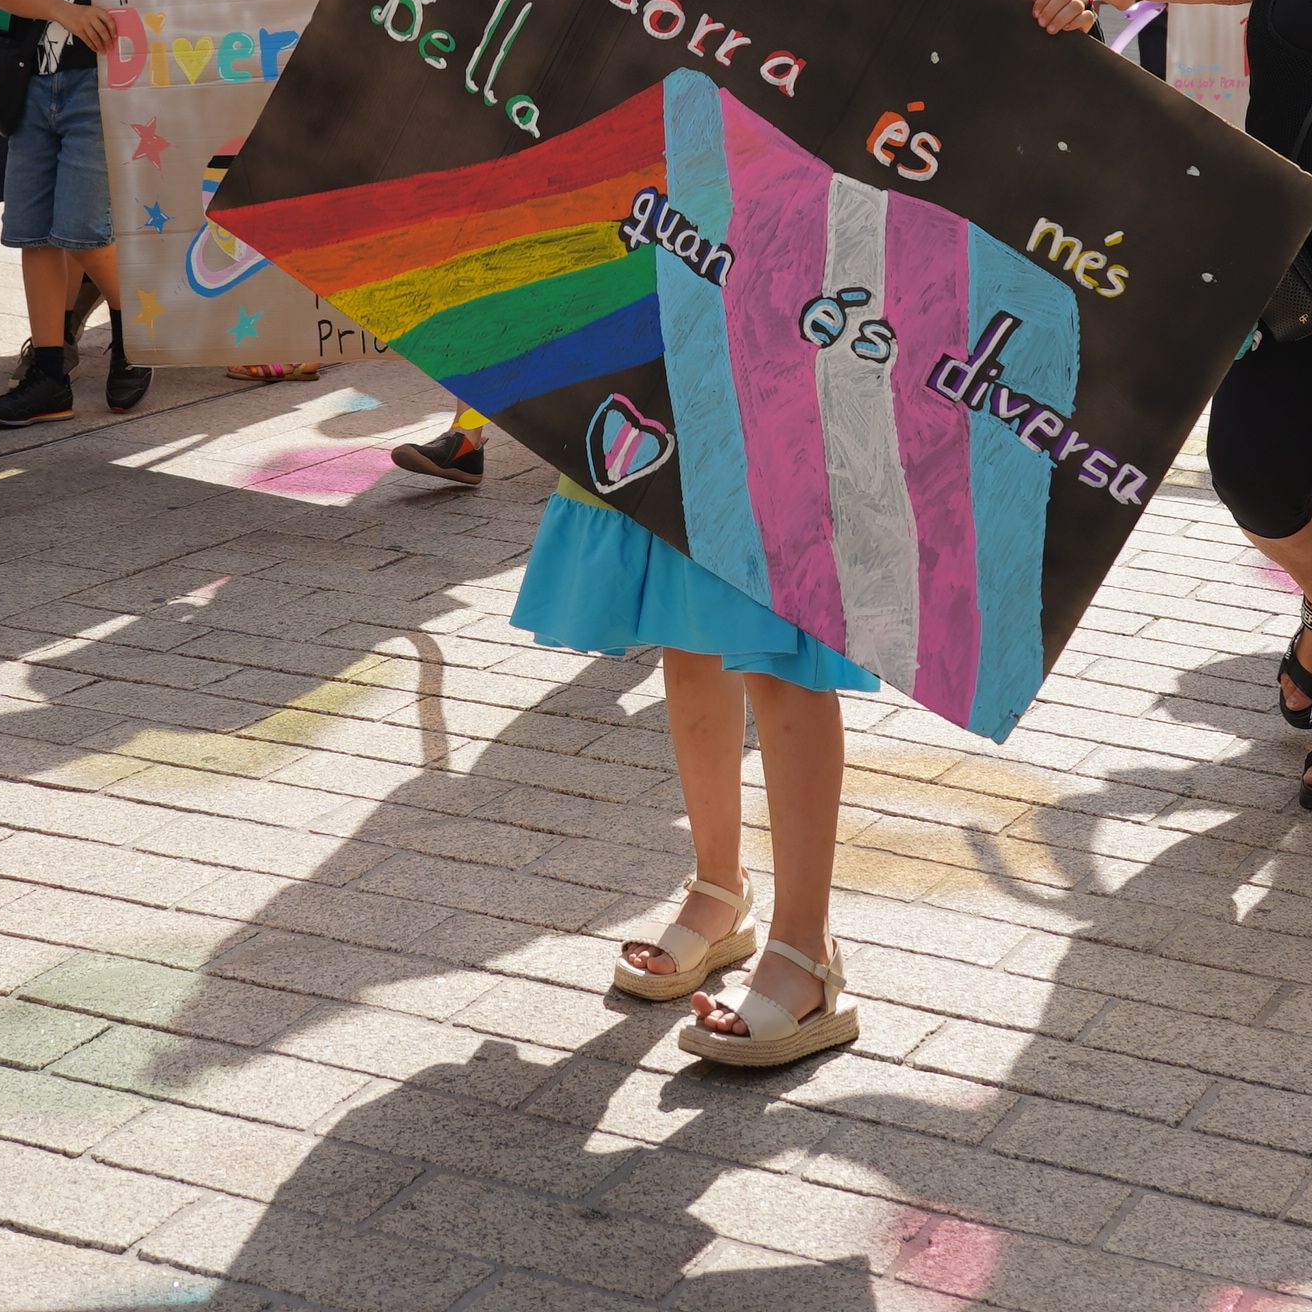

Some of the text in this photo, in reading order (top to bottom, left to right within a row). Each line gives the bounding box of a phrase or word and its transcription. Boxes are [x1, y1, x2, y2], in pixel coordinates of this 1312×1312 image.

[866, 101, 943, 181] és
[1024, 217, 1130, 298] més
[620, 188, 734, 287] quan
[799, 286, 897, 364] és
[926, 310, 1149, 506] diversa
